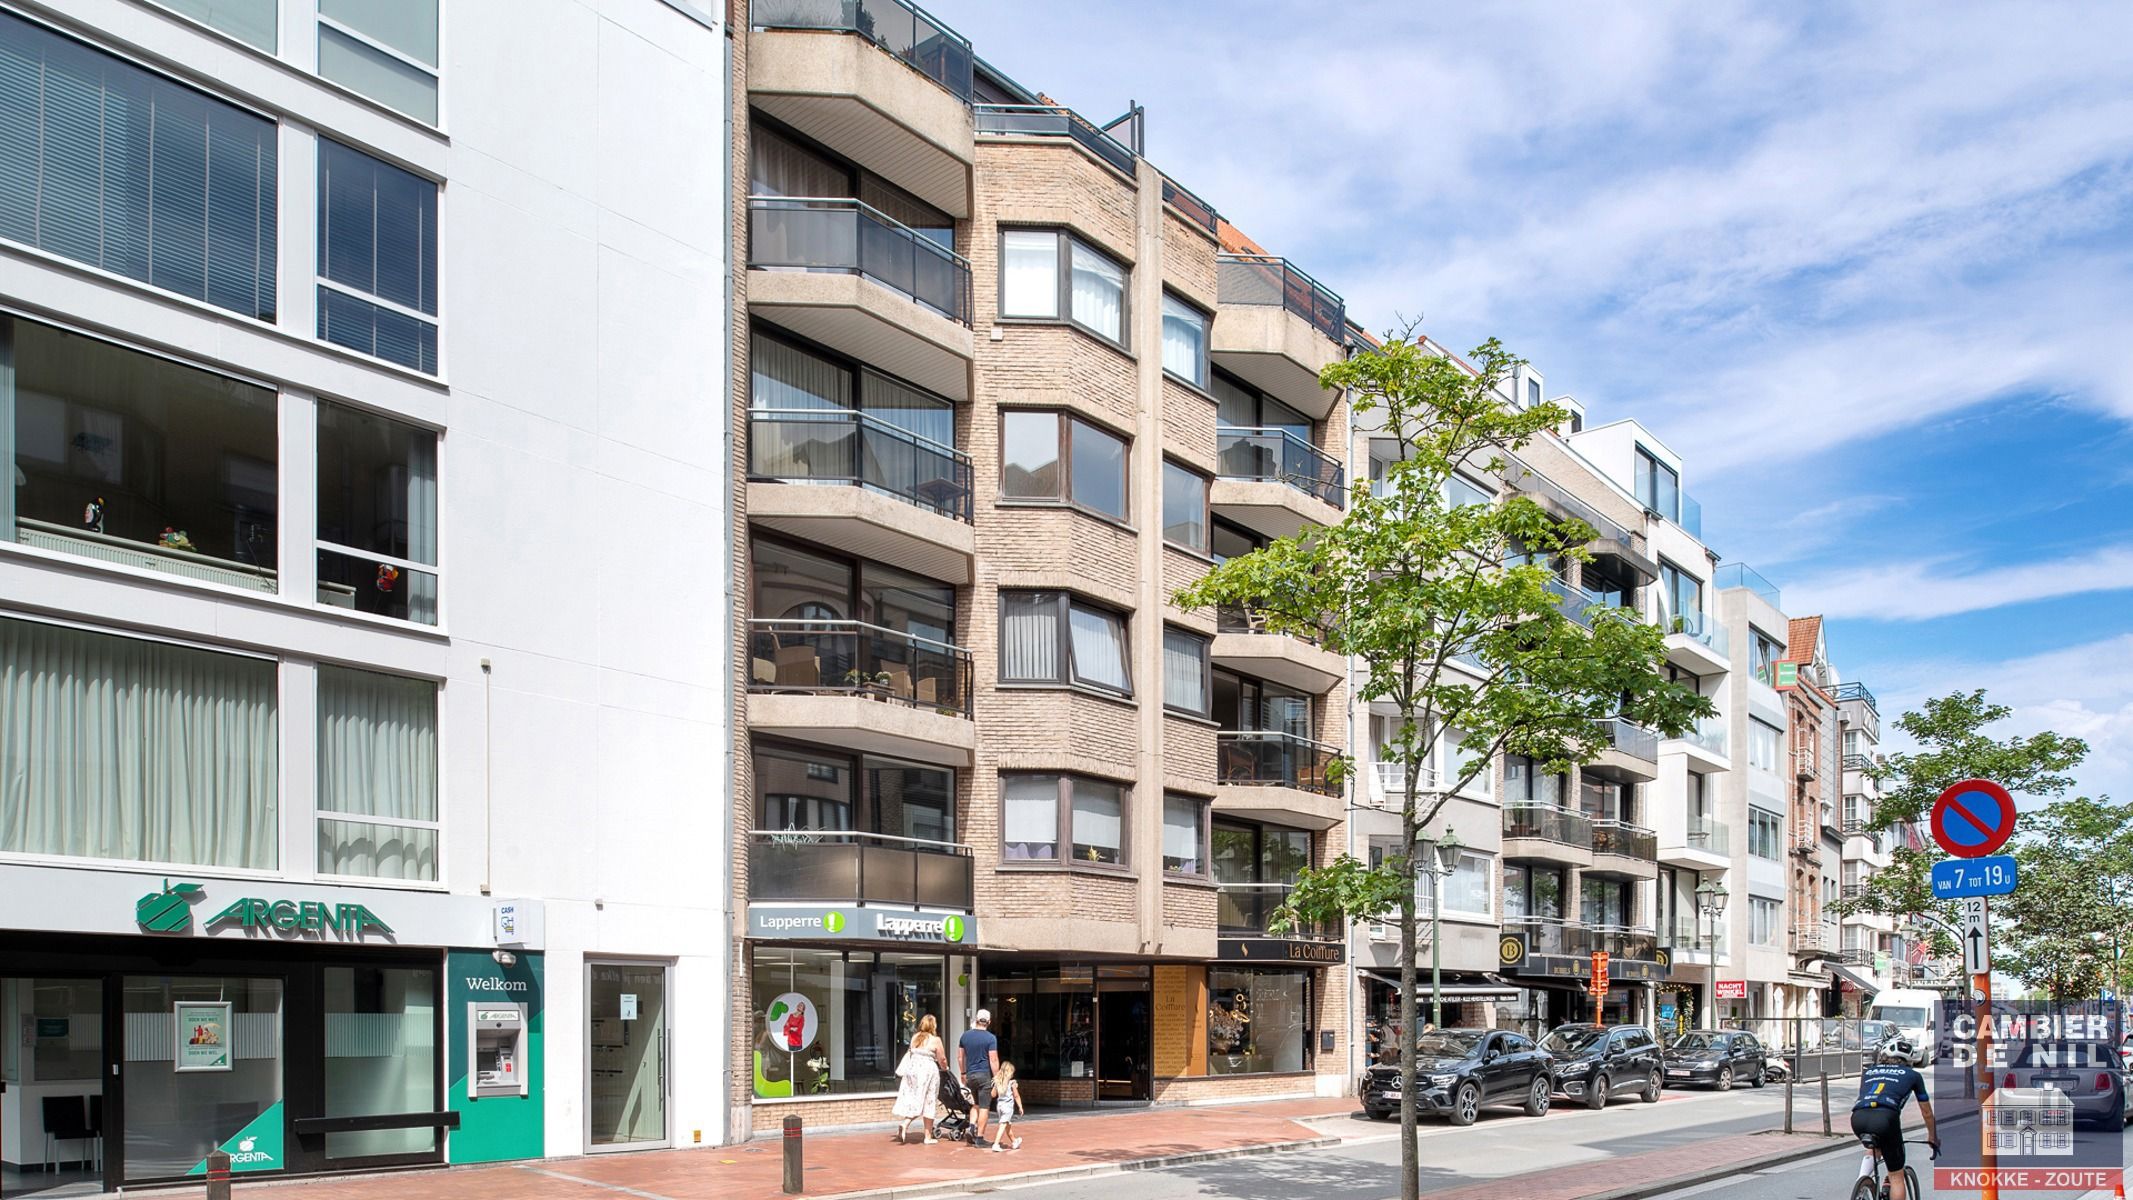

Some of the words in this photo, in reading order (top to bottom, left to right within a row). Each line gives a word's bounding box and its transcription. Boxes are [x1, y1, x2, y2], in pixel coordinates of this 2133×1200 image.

[1938, 880, 1951, 889] VAN
[1954, 869, 1964, 888] 7
[1968, 877, 1982, 887] TOT
[1984, 865, 2002, 886] 19
[2004, 875, 2010, 884] U
[1967, 902, 1980, 912] 12
[203, 897, 396, 933] ARGENTA
[760, 916, 821, 930] Lapperre
[876, 913, 944, 935] Lapperre
[1289, 943, 1300, 958] La
[1303, 944, 1339, 960] Coiffure
[466, 977, 528, 991] Welkom
[229, 1151, 274, 1163] RGENTA
